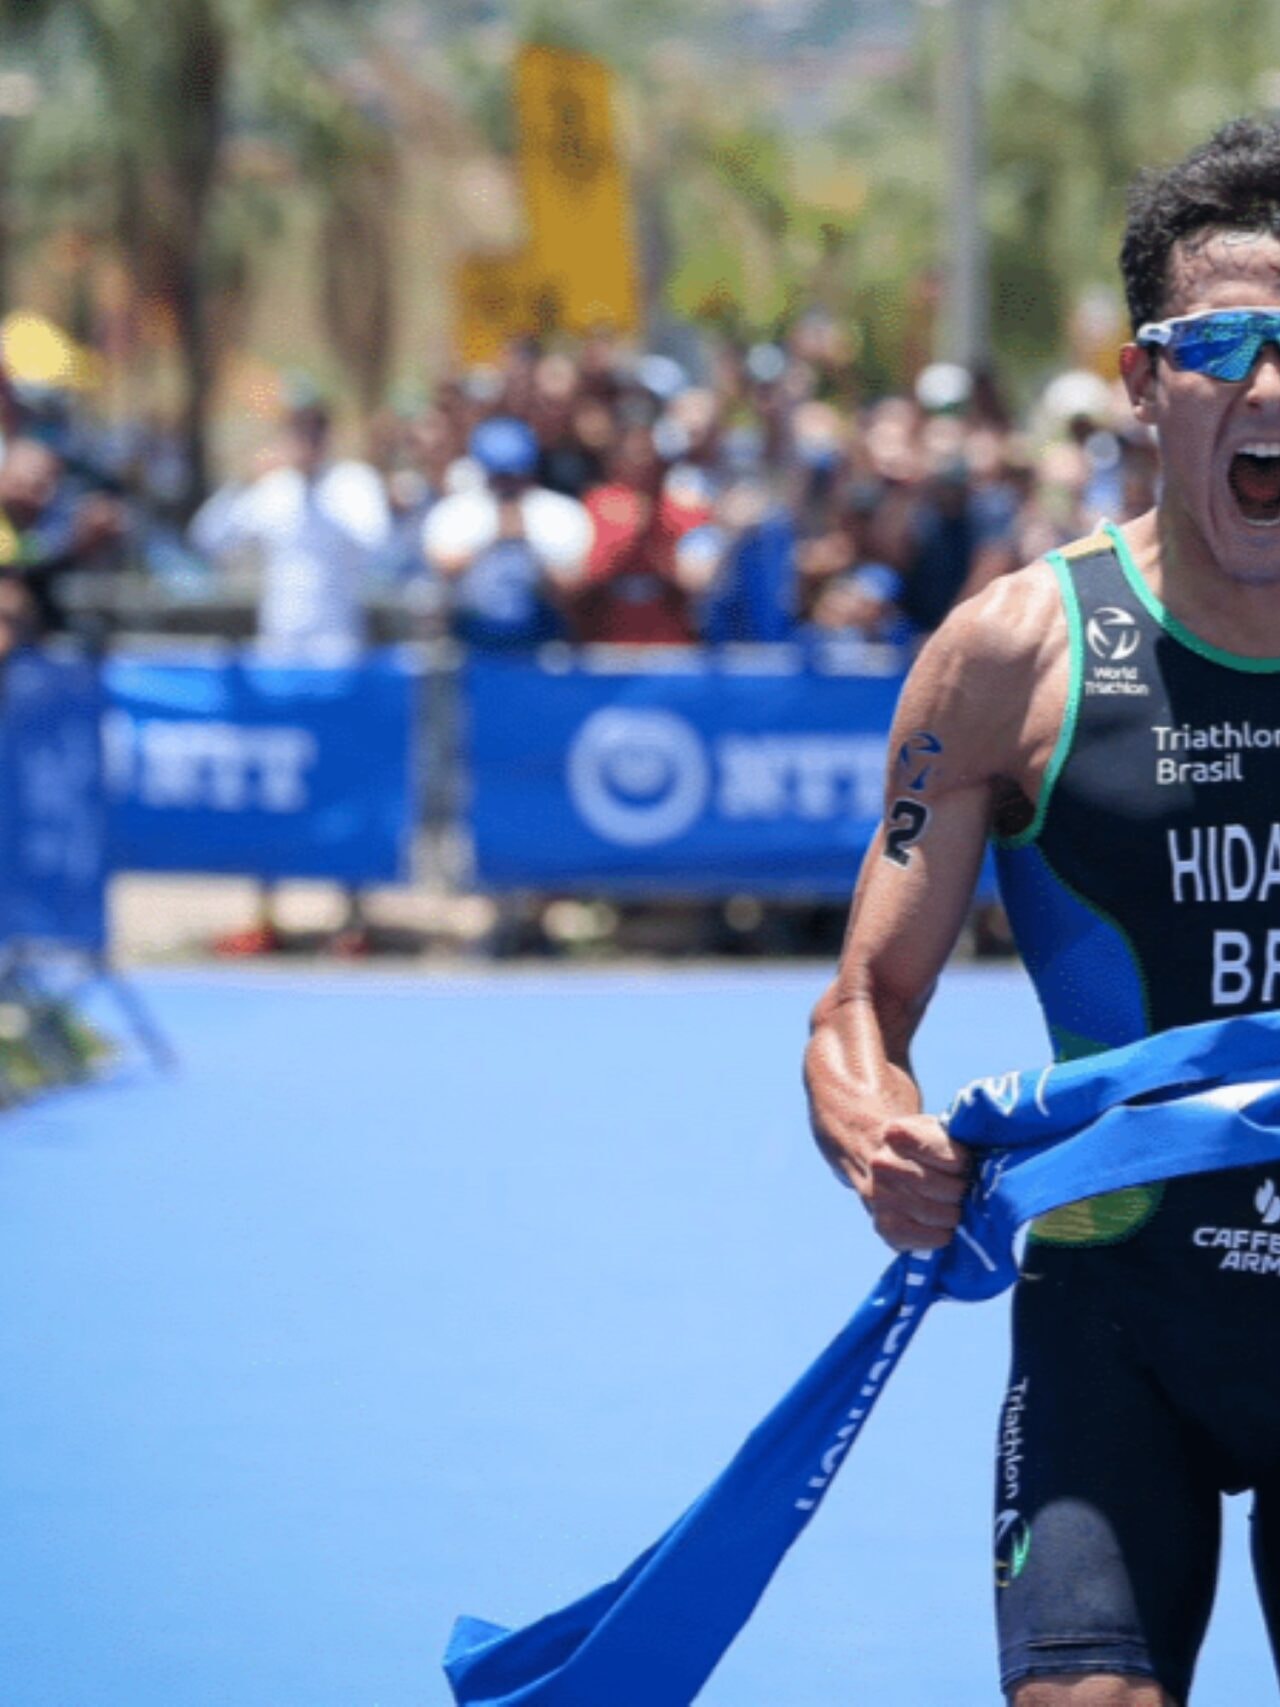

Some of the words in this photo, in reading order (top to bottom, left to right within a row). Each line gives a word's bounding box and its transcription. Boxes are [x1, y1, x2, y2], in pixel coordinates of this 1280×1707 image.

[1156, 753, 1244, 786] Brasil
[883, 798, 931, 869] 2
[1003, 1376, 1029, 1500] Triathlon
